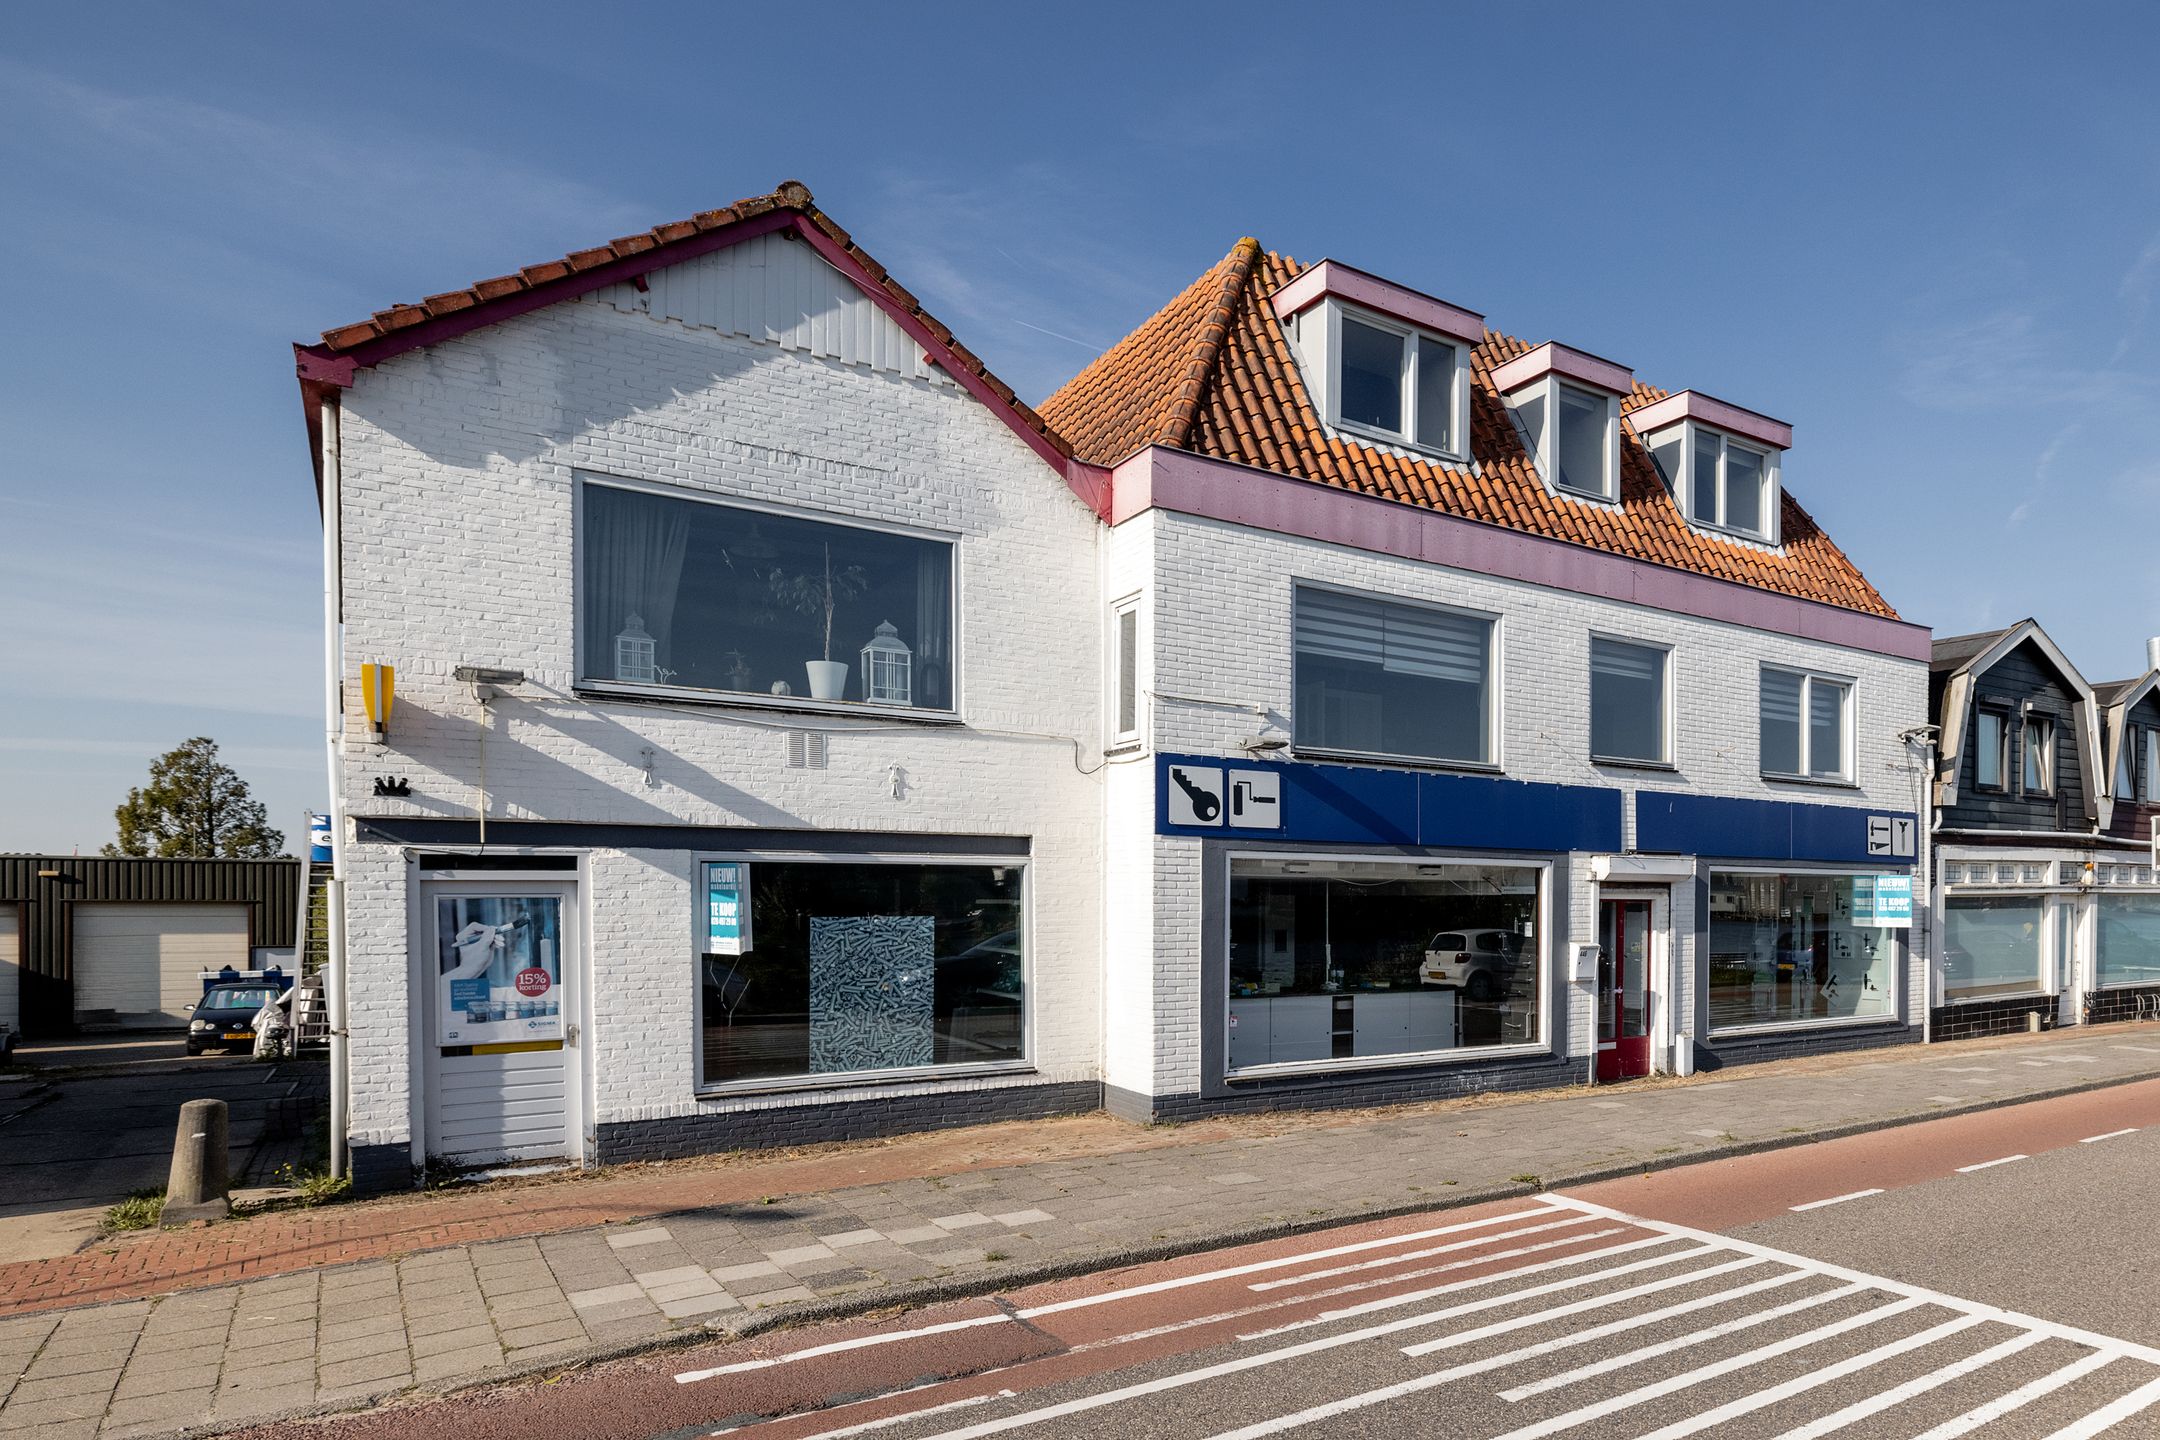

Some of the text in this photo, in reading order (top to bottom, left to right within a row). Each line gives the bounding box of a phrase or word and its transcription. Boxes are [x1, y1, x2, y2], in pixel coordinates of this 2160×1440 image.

[710, 867, 736, 883] NIEUW!
[1878, 877, 1910, 887] NIEUW!
[1878, 897, 1888, 906] TE
[1888, 897, 1910, 906] KOOP
[710, 902, 719, 917] TE
[720, 902, 737, 917] KOOP
[518, 973, 547, 985] 15%
